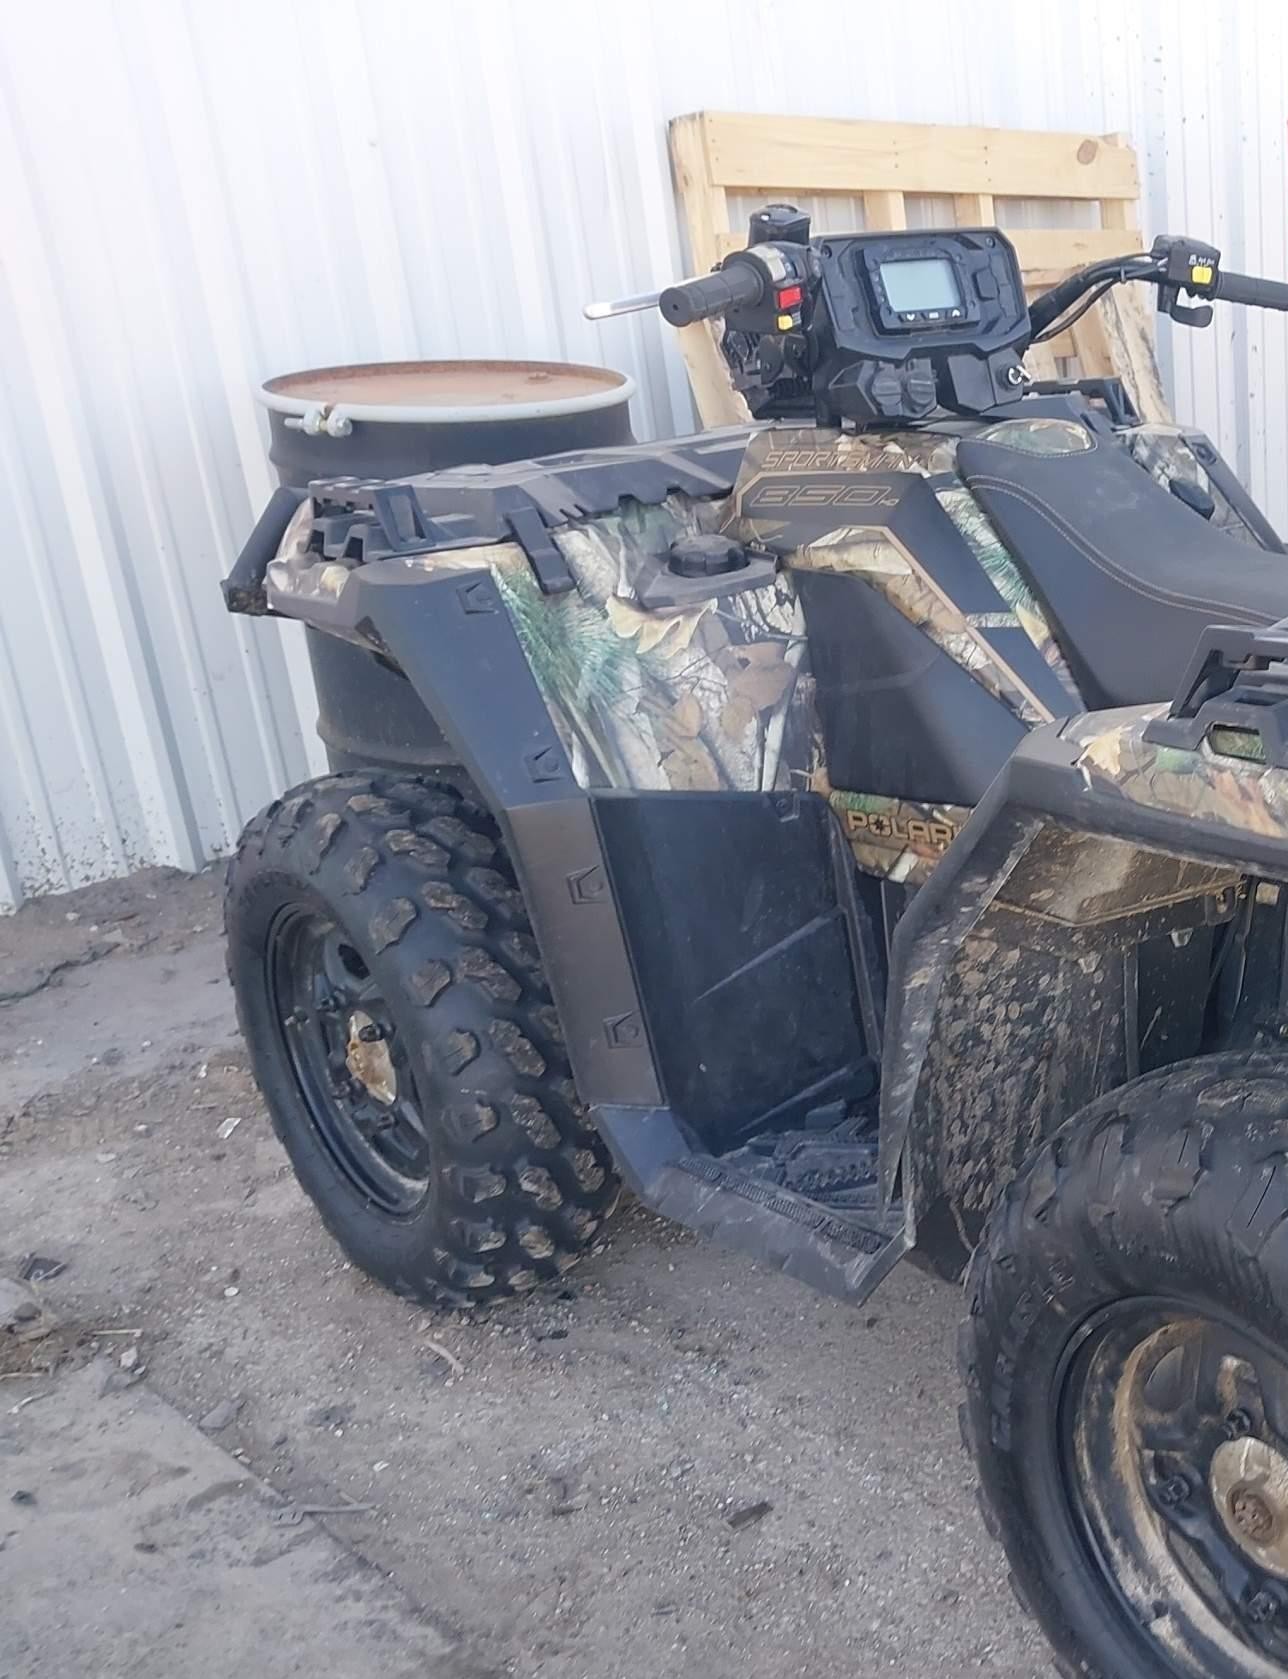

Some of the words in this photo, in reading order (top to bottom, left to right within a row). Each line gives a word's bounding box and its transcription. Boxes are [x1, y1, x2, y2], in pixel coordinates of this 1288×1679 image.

[761, 451, 917, 470] SPORTSMAN
[751, 485, 893, 507] 850
[848, 811, 959, 844] POLAR
